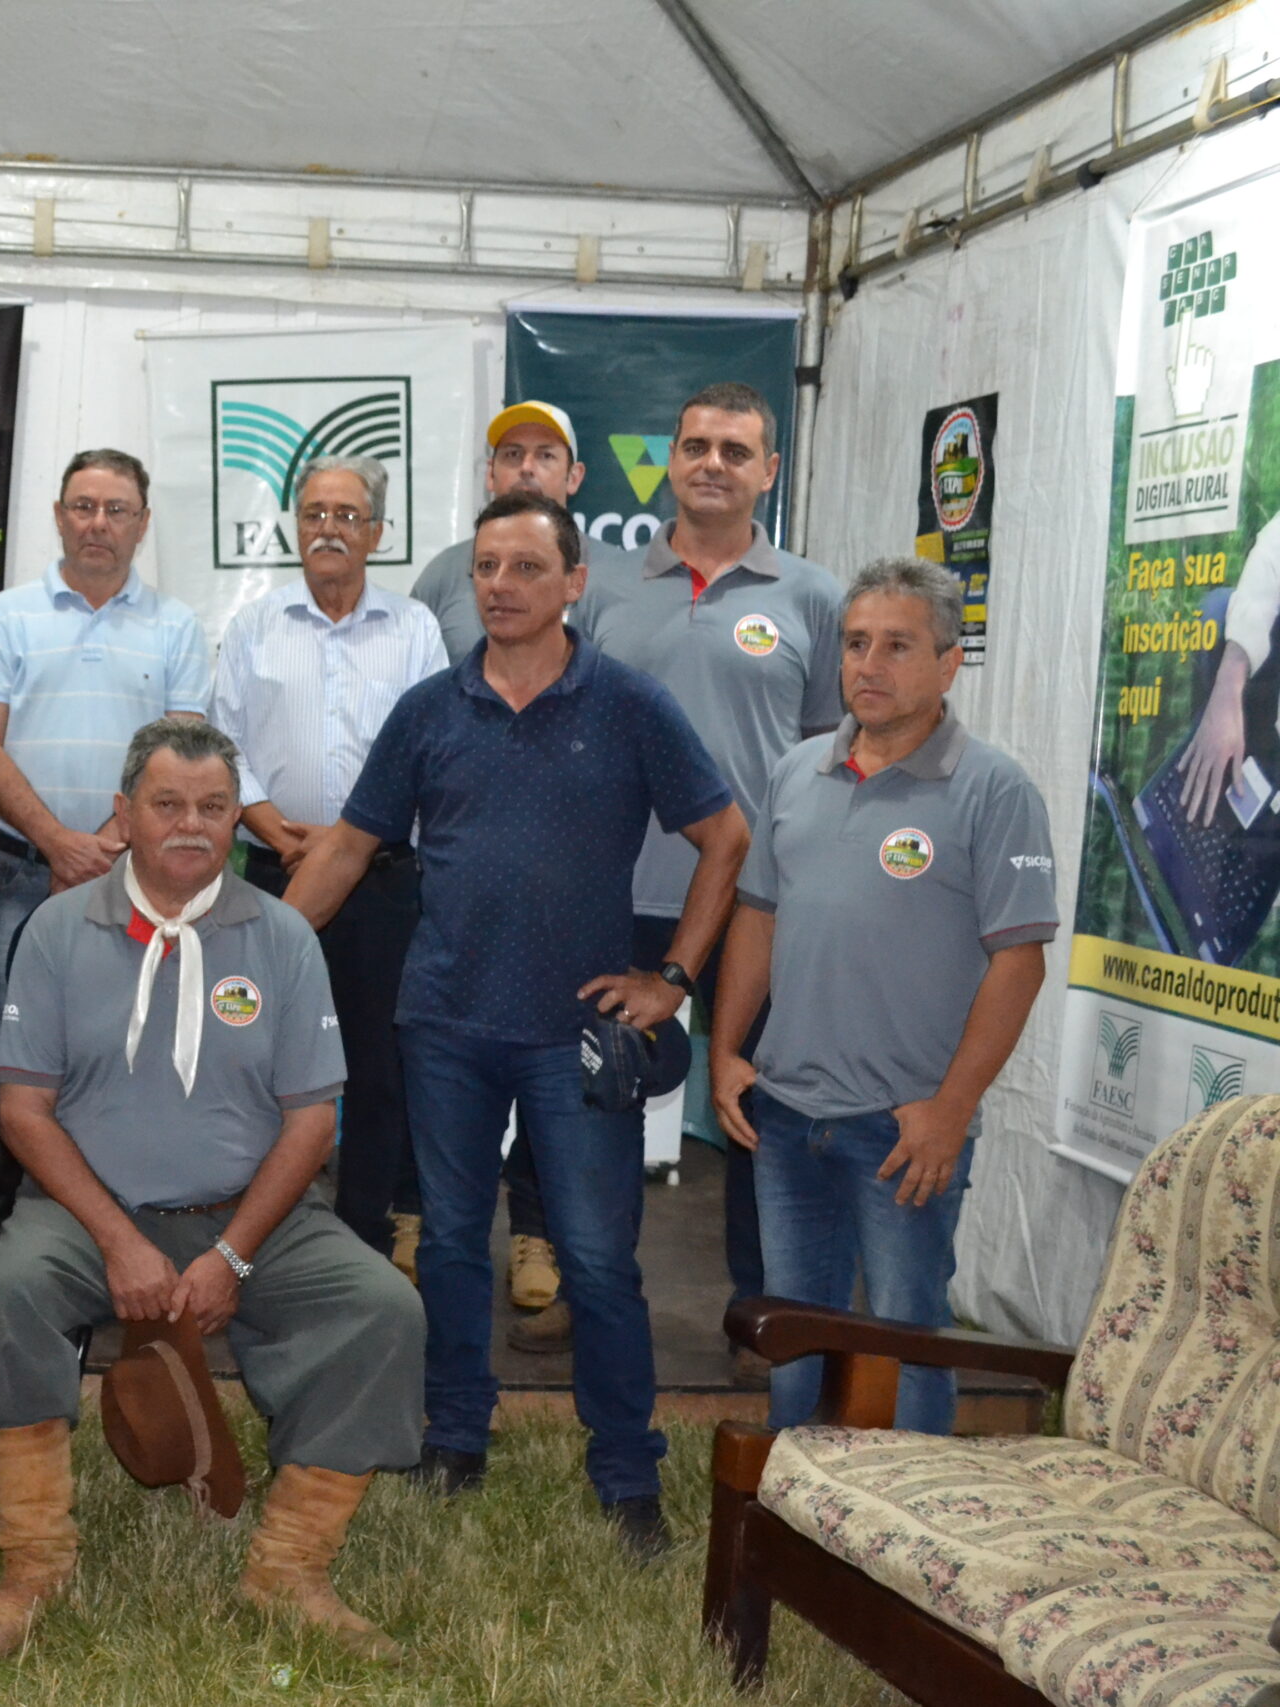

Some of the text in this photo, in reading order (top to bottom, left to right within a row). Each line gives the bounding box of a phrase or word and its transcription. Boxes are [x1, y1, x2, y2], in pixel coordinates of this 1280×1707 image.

[1168, 235, 1208, 259] CNA
[1160, 256, 1232, 290] SENAR
[1138, 417, 1235, 480] INCLUSÃO
[1136, 472, 1228, 512] DIGITAL RURAL
[1127, 551, 1227, 600] Faça sua
[1123, 610, 1218, 664] inscrição
[1118, 676, 1162, 725] aqui
[1092, 1080, 1135, 1113] FAESC
